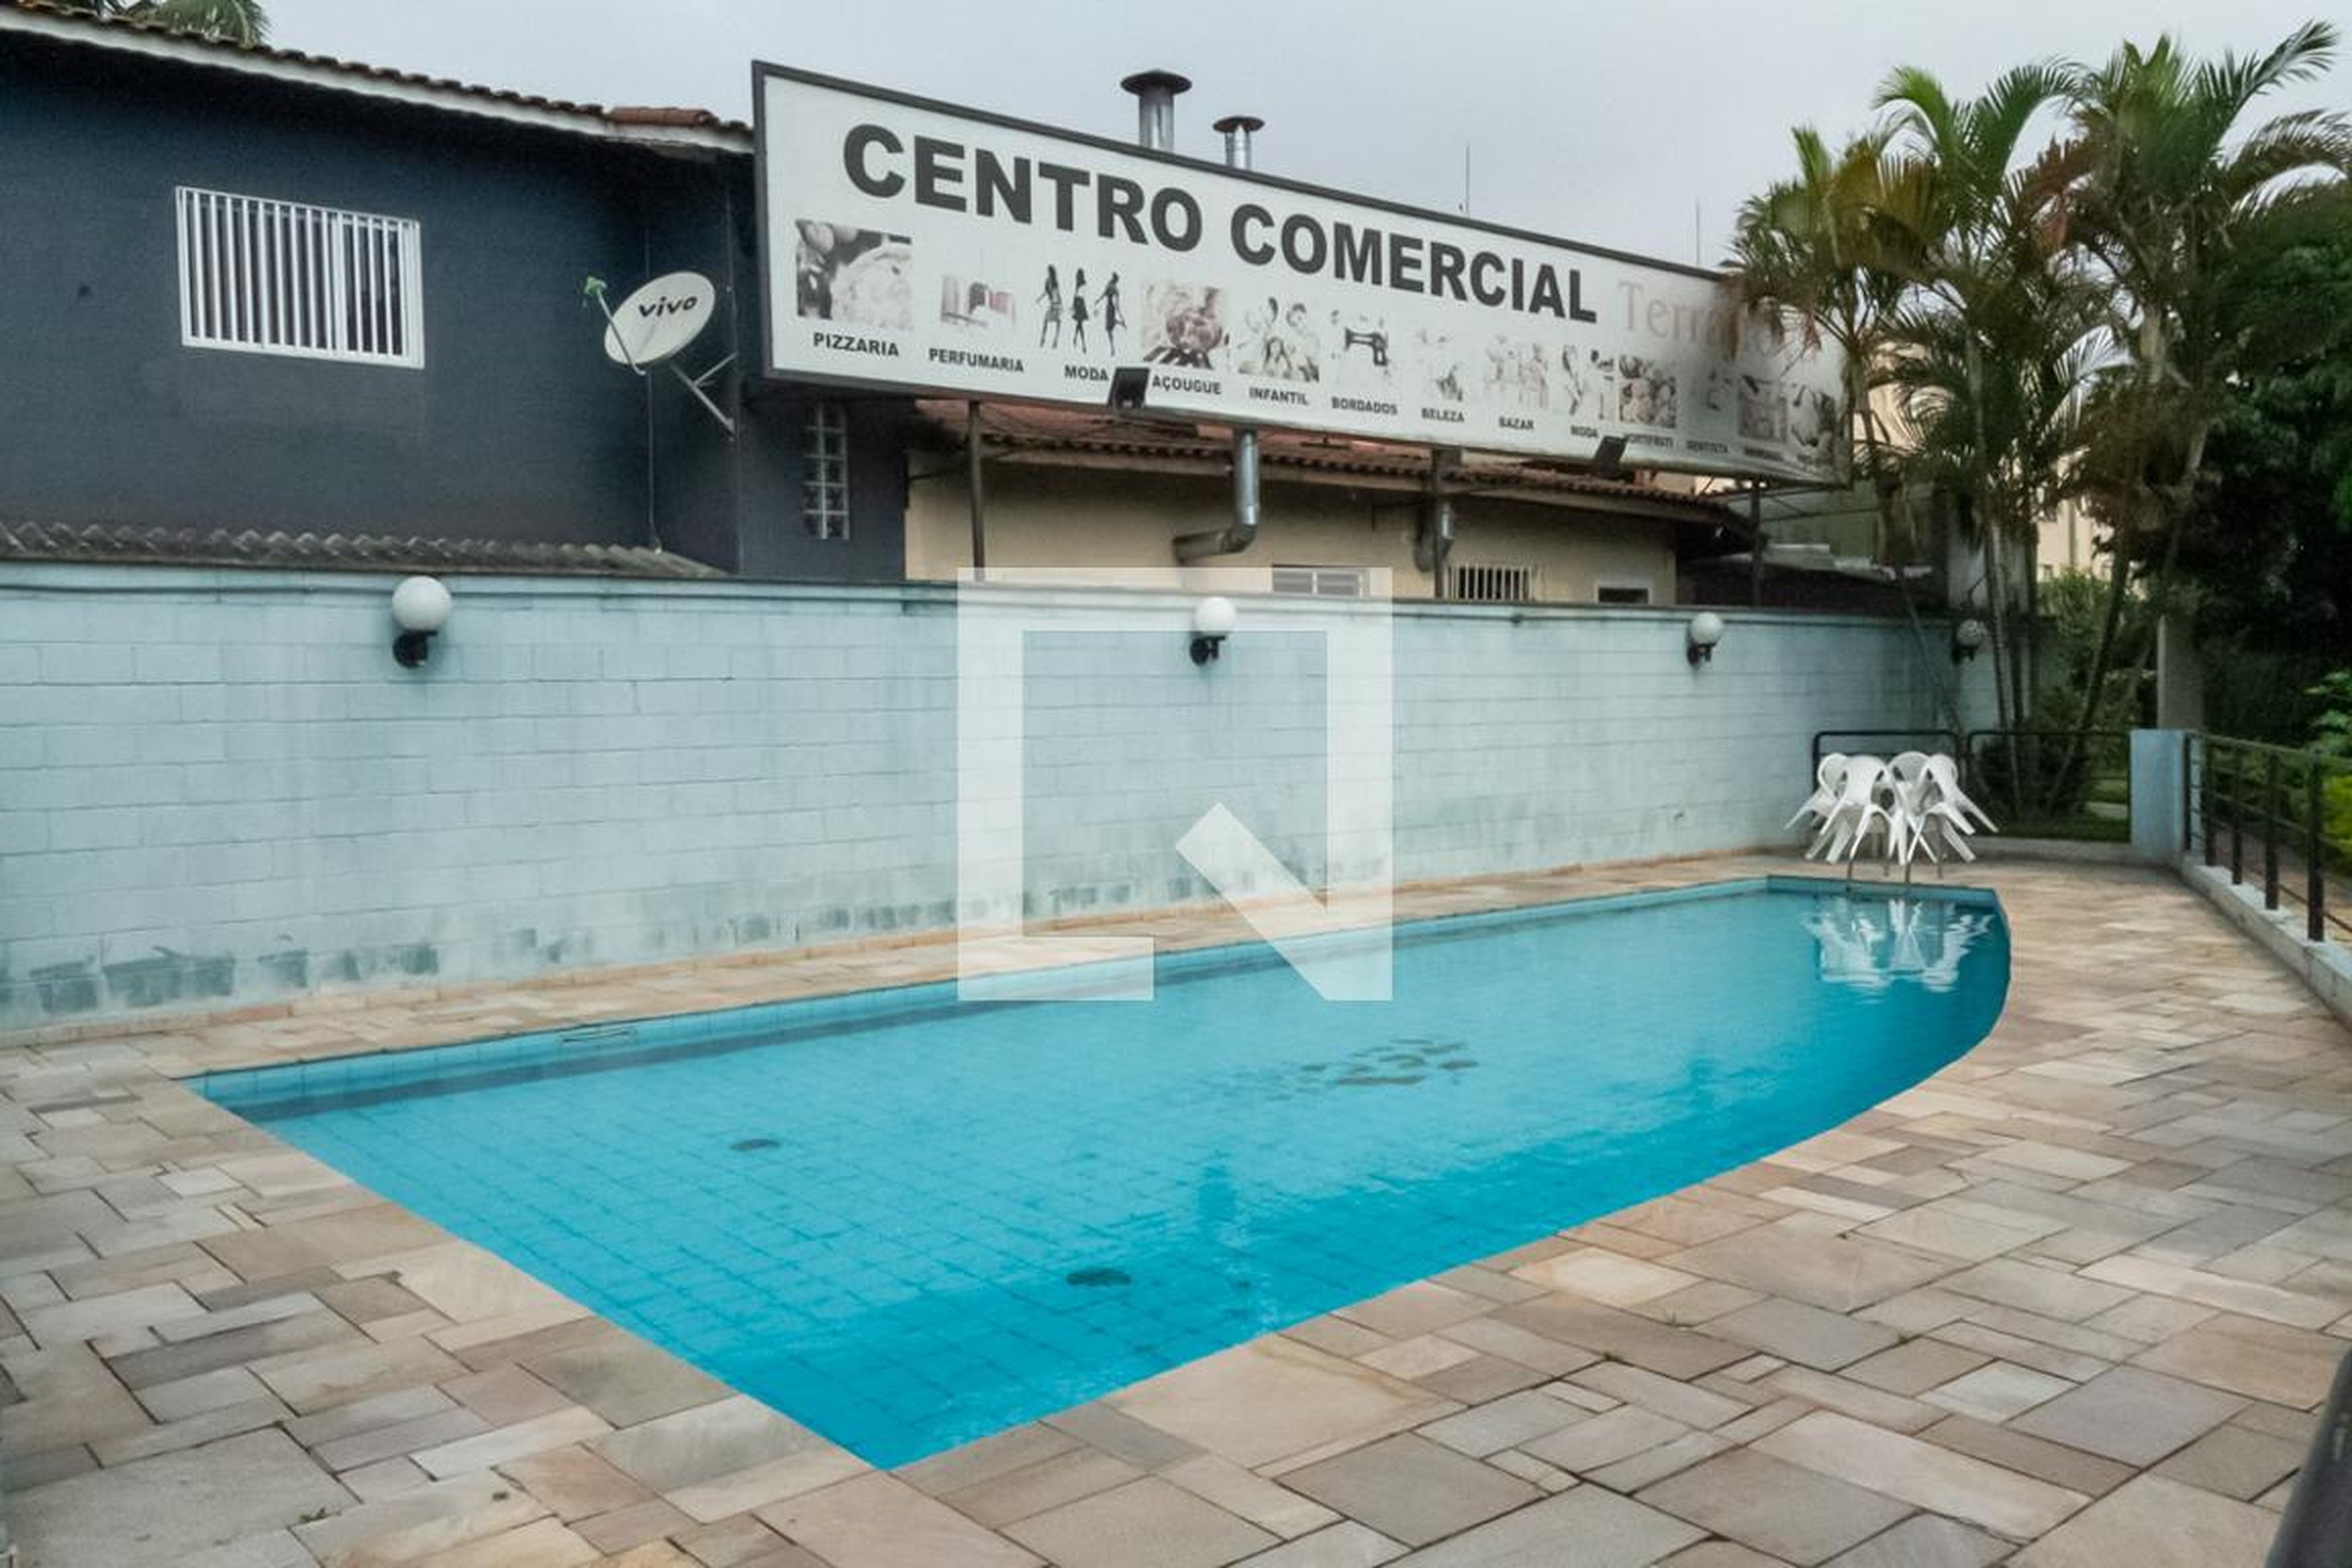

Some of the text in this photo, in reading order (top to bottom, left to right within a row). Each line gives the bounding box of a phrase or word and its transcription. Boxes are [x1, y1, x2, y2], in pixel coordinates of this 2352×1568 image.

[844, 124, 1202, 252] CENTRO
[1231, 204, 1597, 324] COMERCIAL
[639, 296, 698, 317] vivo
[813, 332, 899, 356] PIZZARIA
[929, 348, 1024, 372] PERFUMARIA
[1065, 364, 1109, 381] MODA
[1152, 374, 1221, 395] AÇOUGUE
[1249, 386, 1309, 405] INFANTIL
[1332, 396, 1398, 415] BORDADOS
[1422, 407, 1464, 423] BELEZA
[1498, 417, 1534, 431] BAZAR
